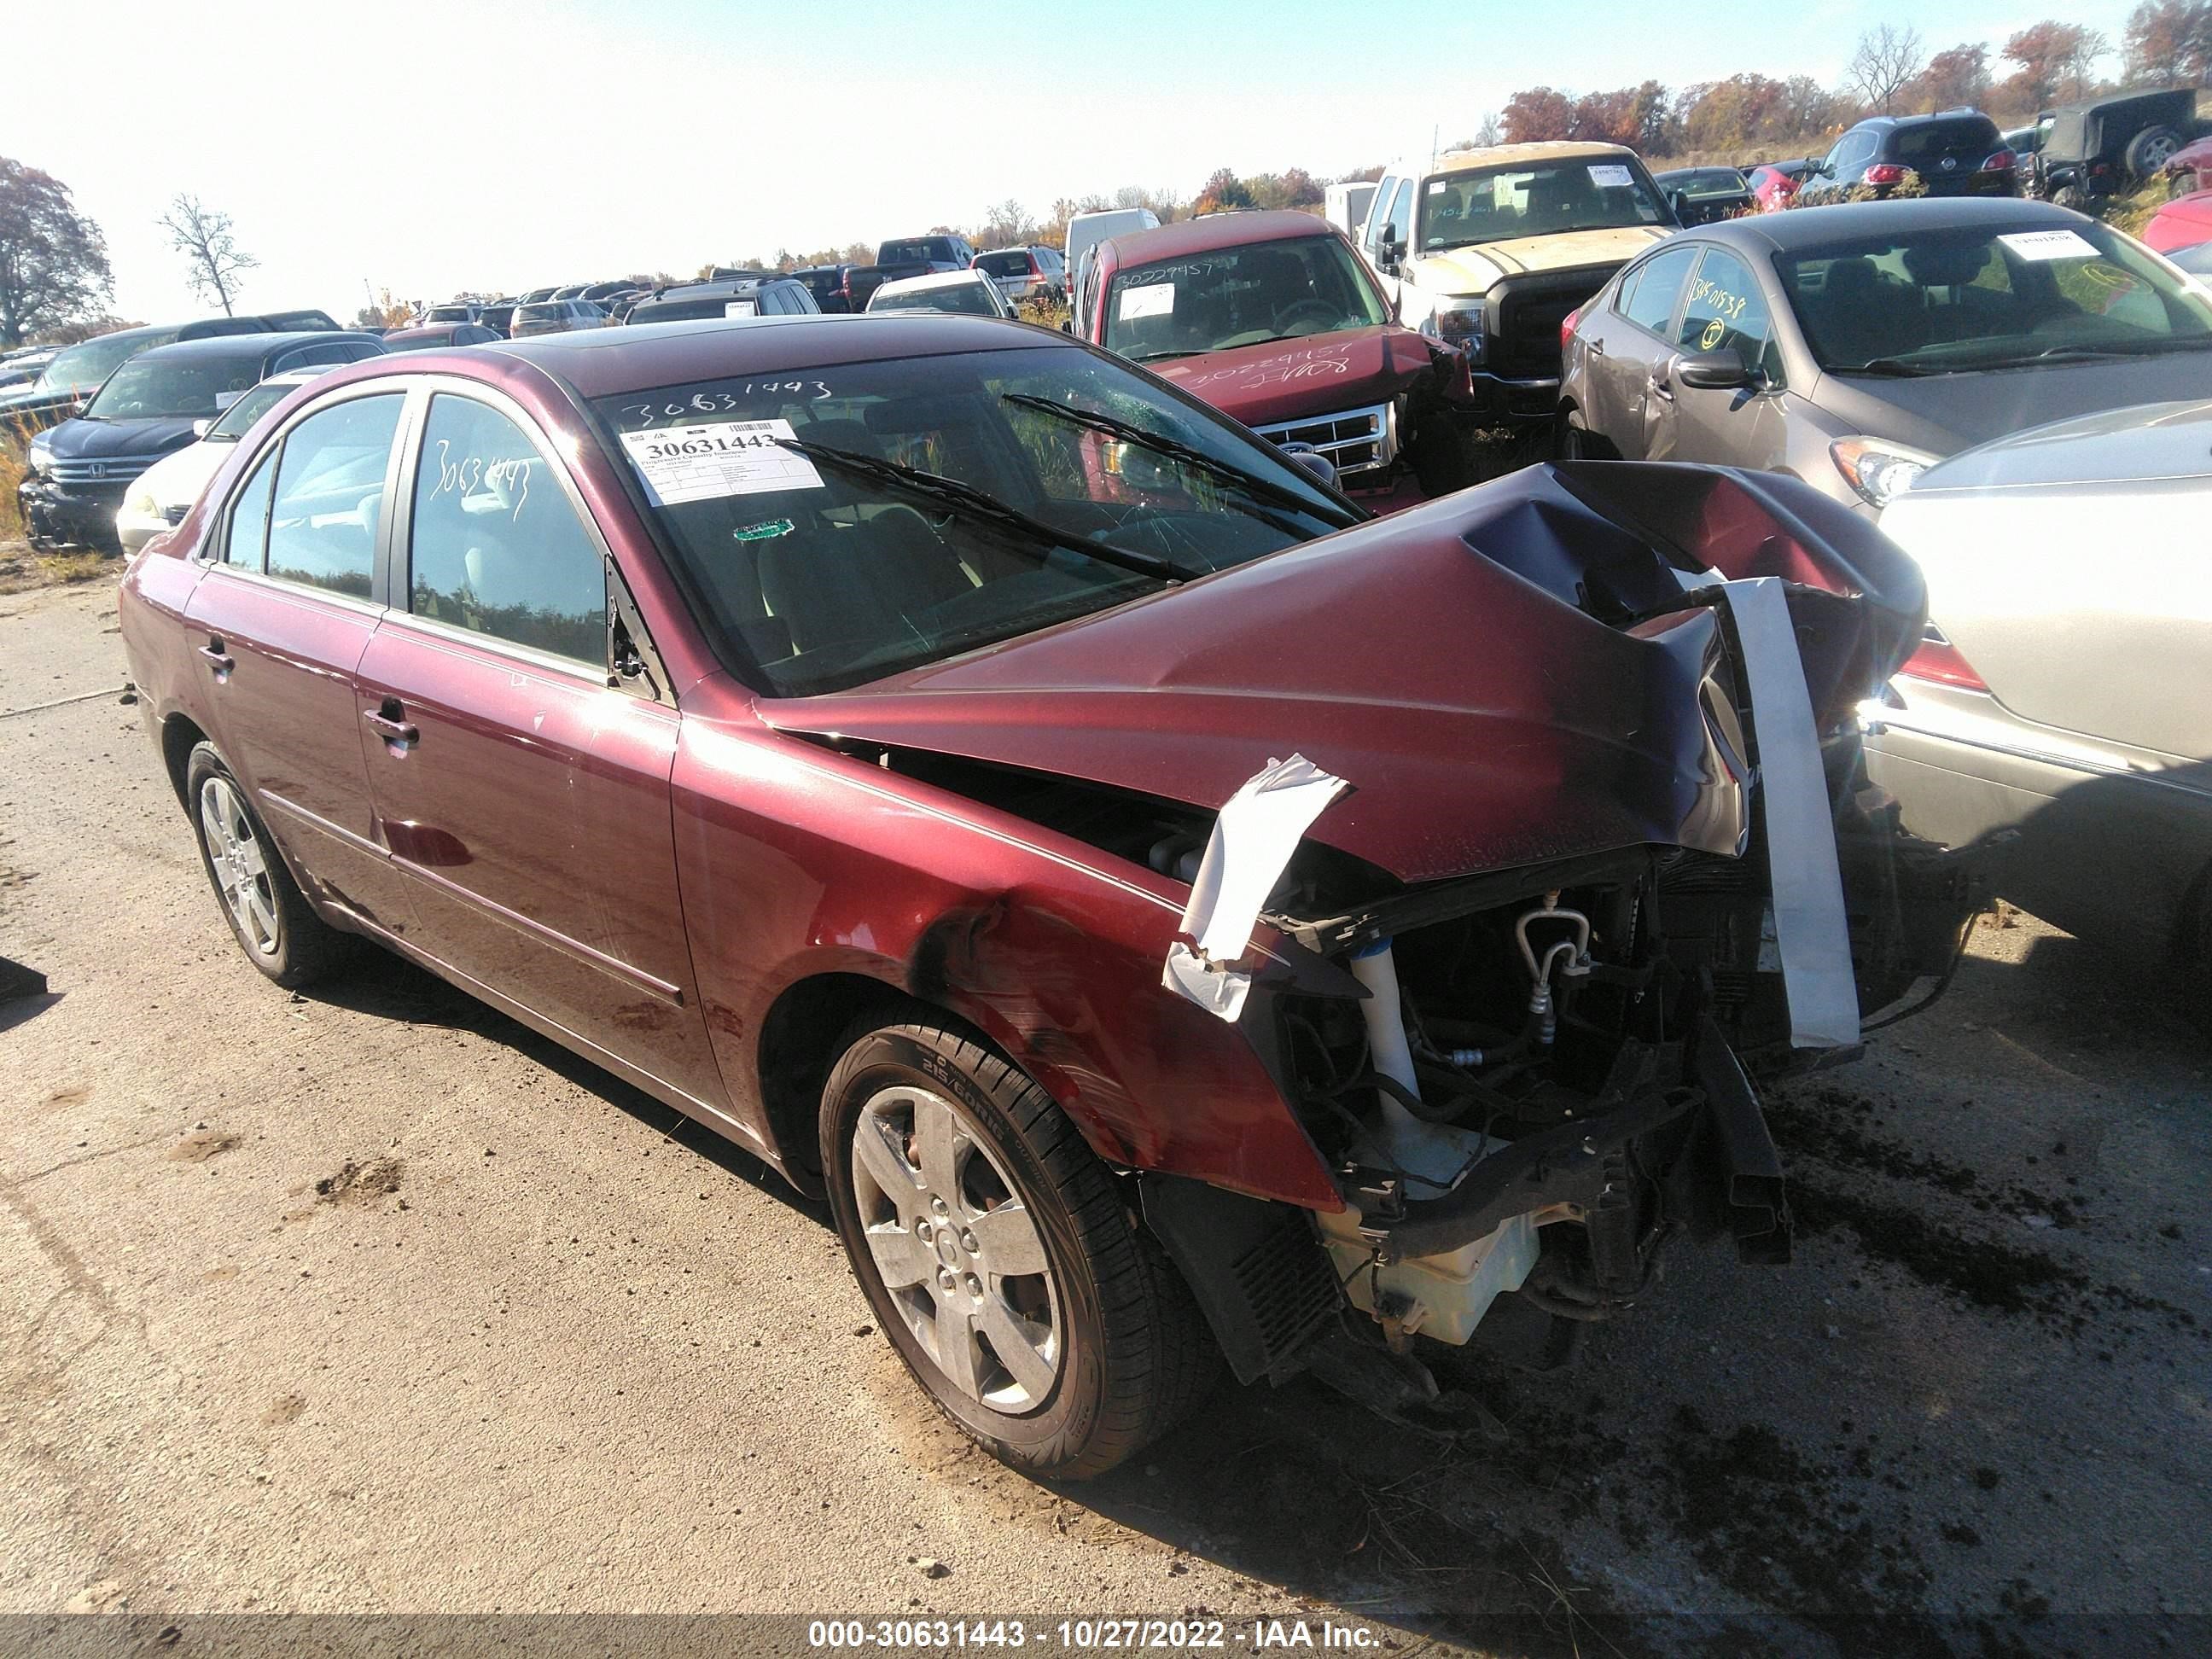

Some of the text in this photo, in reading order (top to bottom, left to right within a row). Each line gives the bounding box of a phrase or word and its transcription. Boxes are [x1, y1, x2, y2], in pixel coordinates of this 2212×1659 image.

[1113, 263, 1213, 294] 30229457
[1692, 278, 1747, 320] 34501838
[641, 456, 682, 466] Progressive
[682, 452, 713, 461] Casualty
[646, 434, 776, 459] 30631443
[429, 439, 531, 523] 30631443
